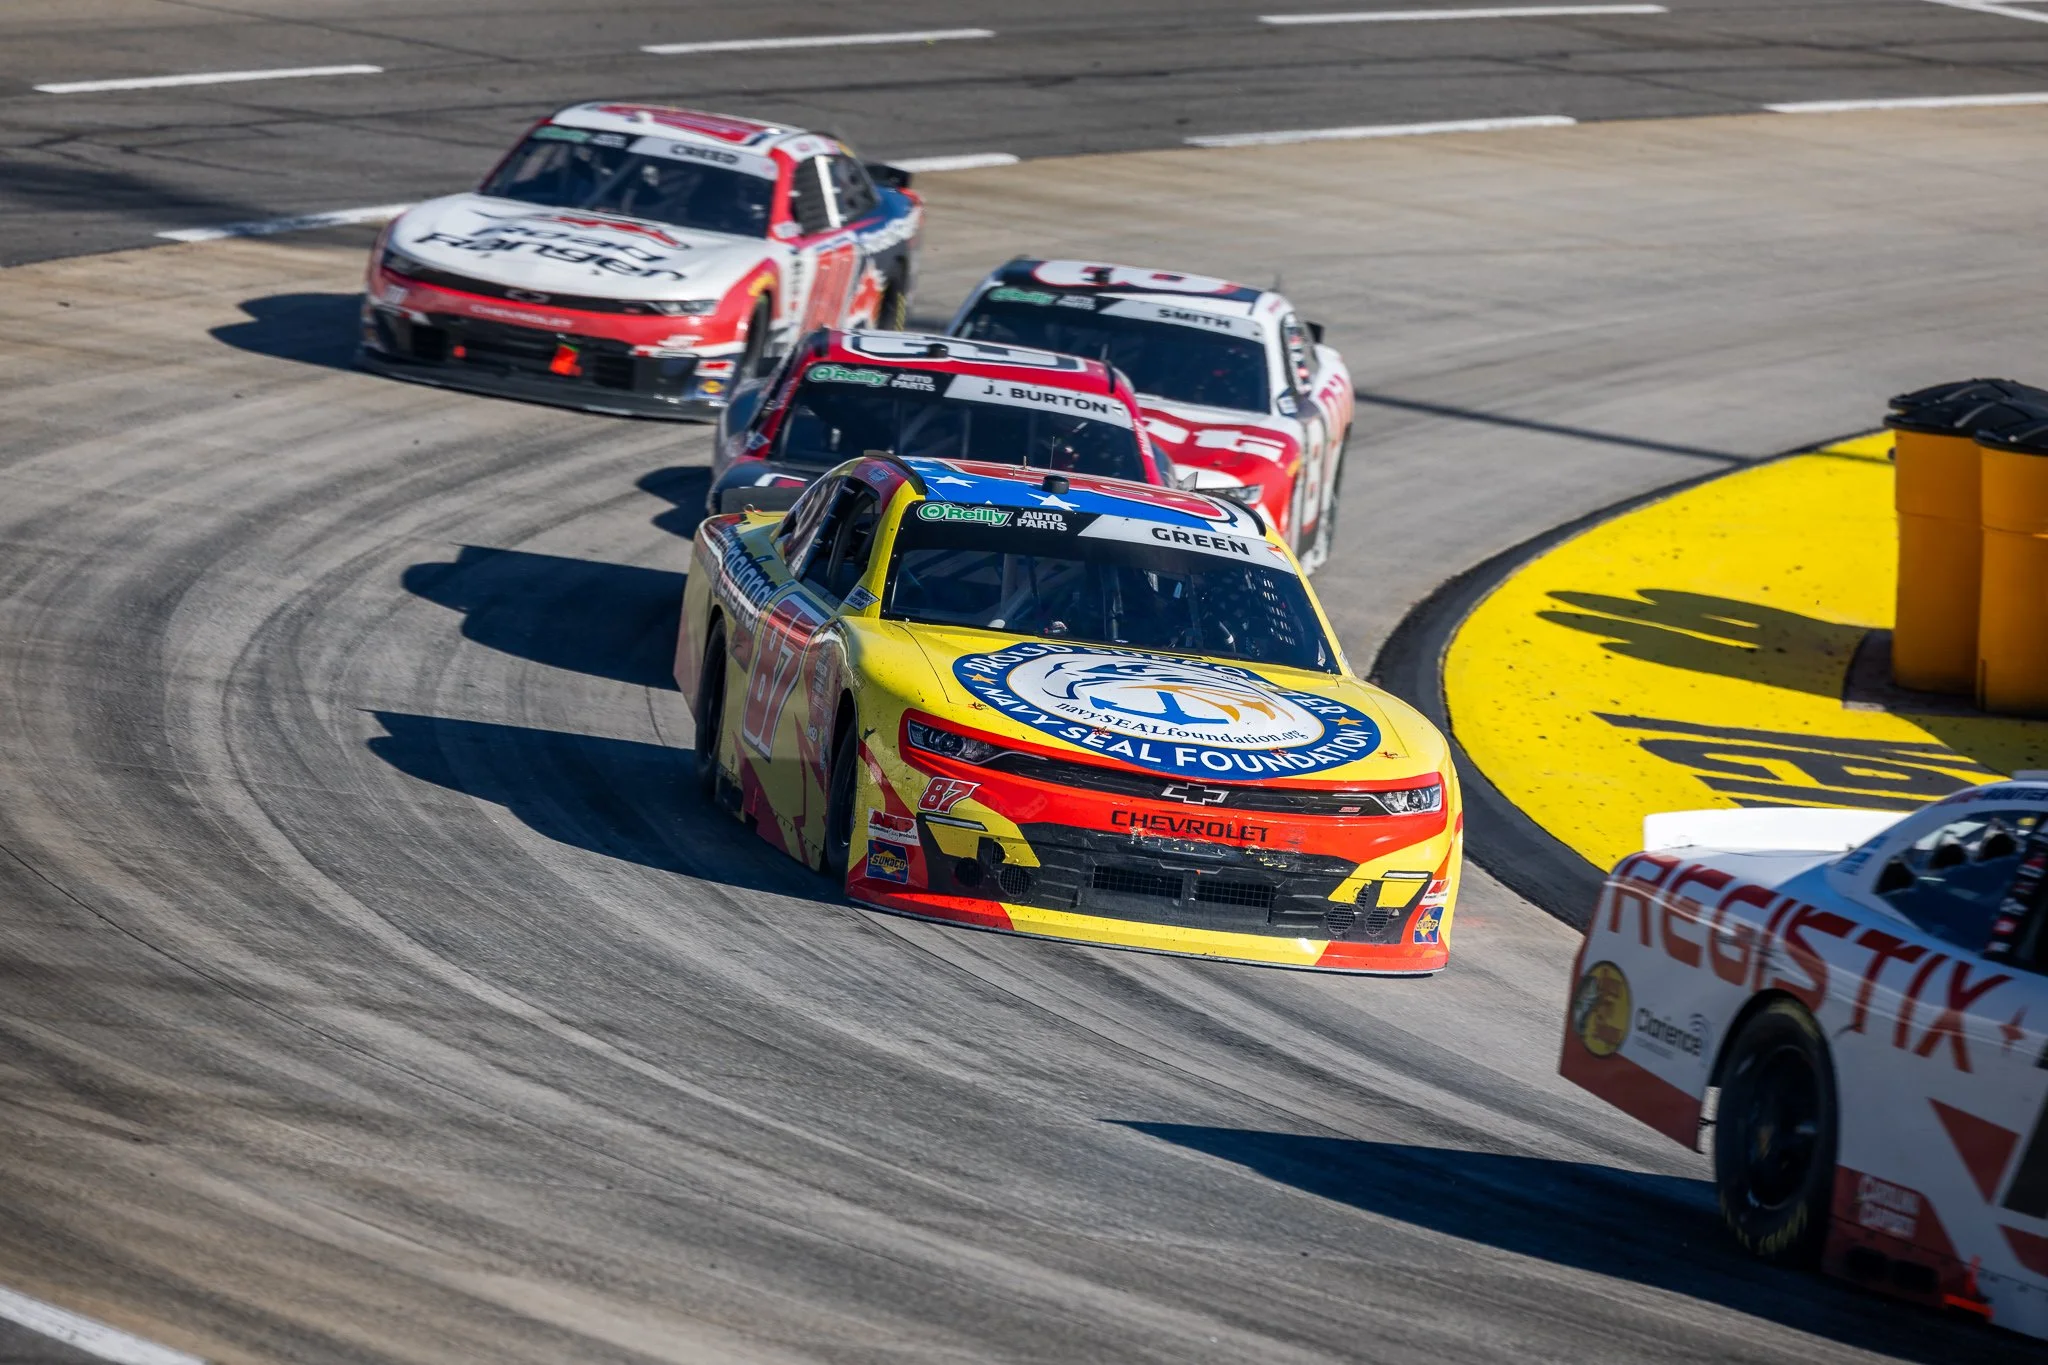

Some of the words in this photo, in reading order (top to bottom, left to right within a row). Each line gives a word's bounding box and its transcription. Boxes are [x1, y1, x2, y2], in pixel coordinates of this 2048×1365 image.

[670, 143, 740, 165] CREED
[413, 232, 687, 281] Ranger
[1158, 307, 1232, 330] SMITH
[890, 379, 936, 392] PARTS
[982, 384, 1003, 397] J.
[1010, 387, 1108, 414] BURTON
[918, 502, 1010, 526] O'Reilly
[1016, 518, 1068, 532] PARTS
[1022, 510, 1063, 522] AUTO
[1151, 526, 1250, 555] GREEN
[962, 643, 1074, 675] PROUD
[742, 590, 834, 763] 87
[974, 685, 1066, 725] NAVY
[1058, 726, 1162, 763] SEAL
[1174, 728, 1373, 773] FOUNDATION
[917, 776, 982, 815] 87
[1111, 809, 1270, 843] CHEVROLET
[870, 854, 906, 870] SUNOCO
